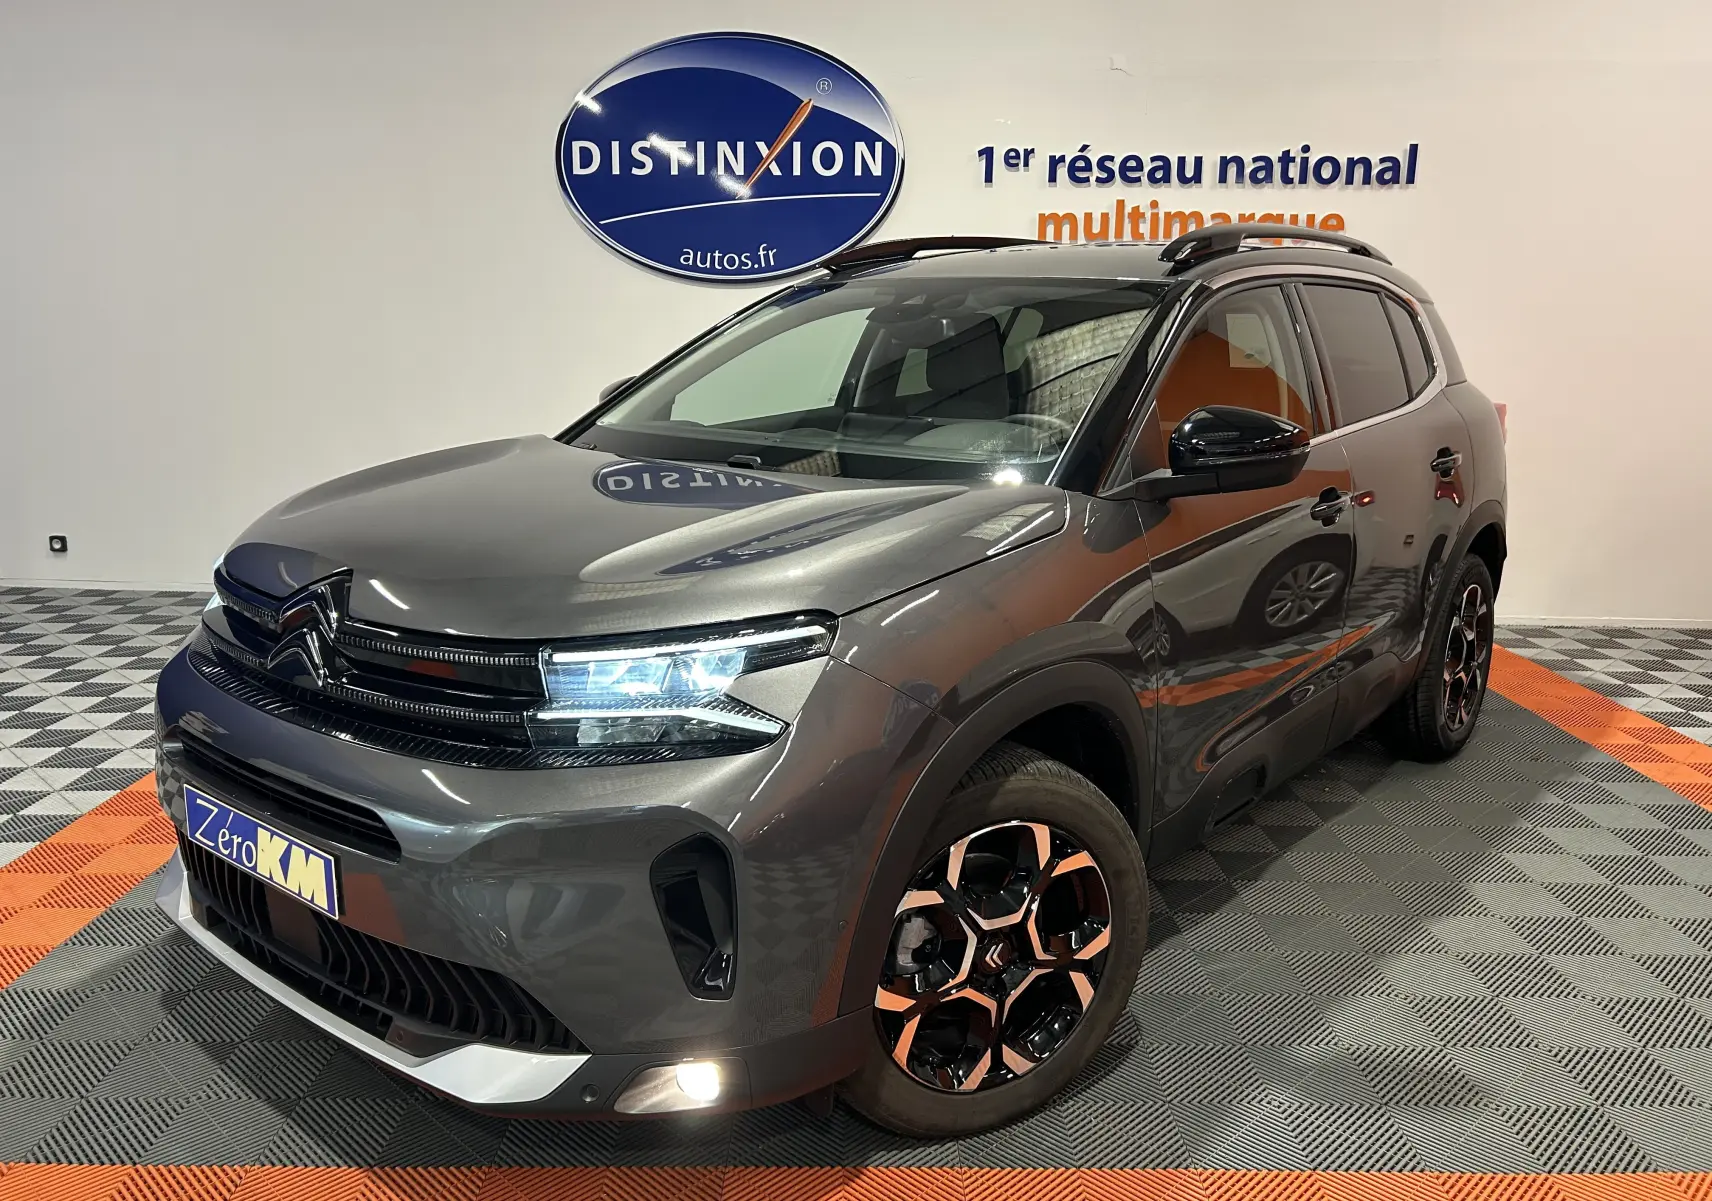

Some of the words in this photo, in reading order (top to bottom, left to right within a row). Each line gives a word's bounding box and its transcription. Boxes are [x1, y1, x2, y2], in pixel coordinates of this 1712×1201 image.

[571, 140, 883, 176] DISTINXION
[977, 145, 1035, 184] 1er
[1047, 143, 1202, 185] réseau
[1218, 143, 1419, 185] national
[679, 244, 777, 270] autos.fr
